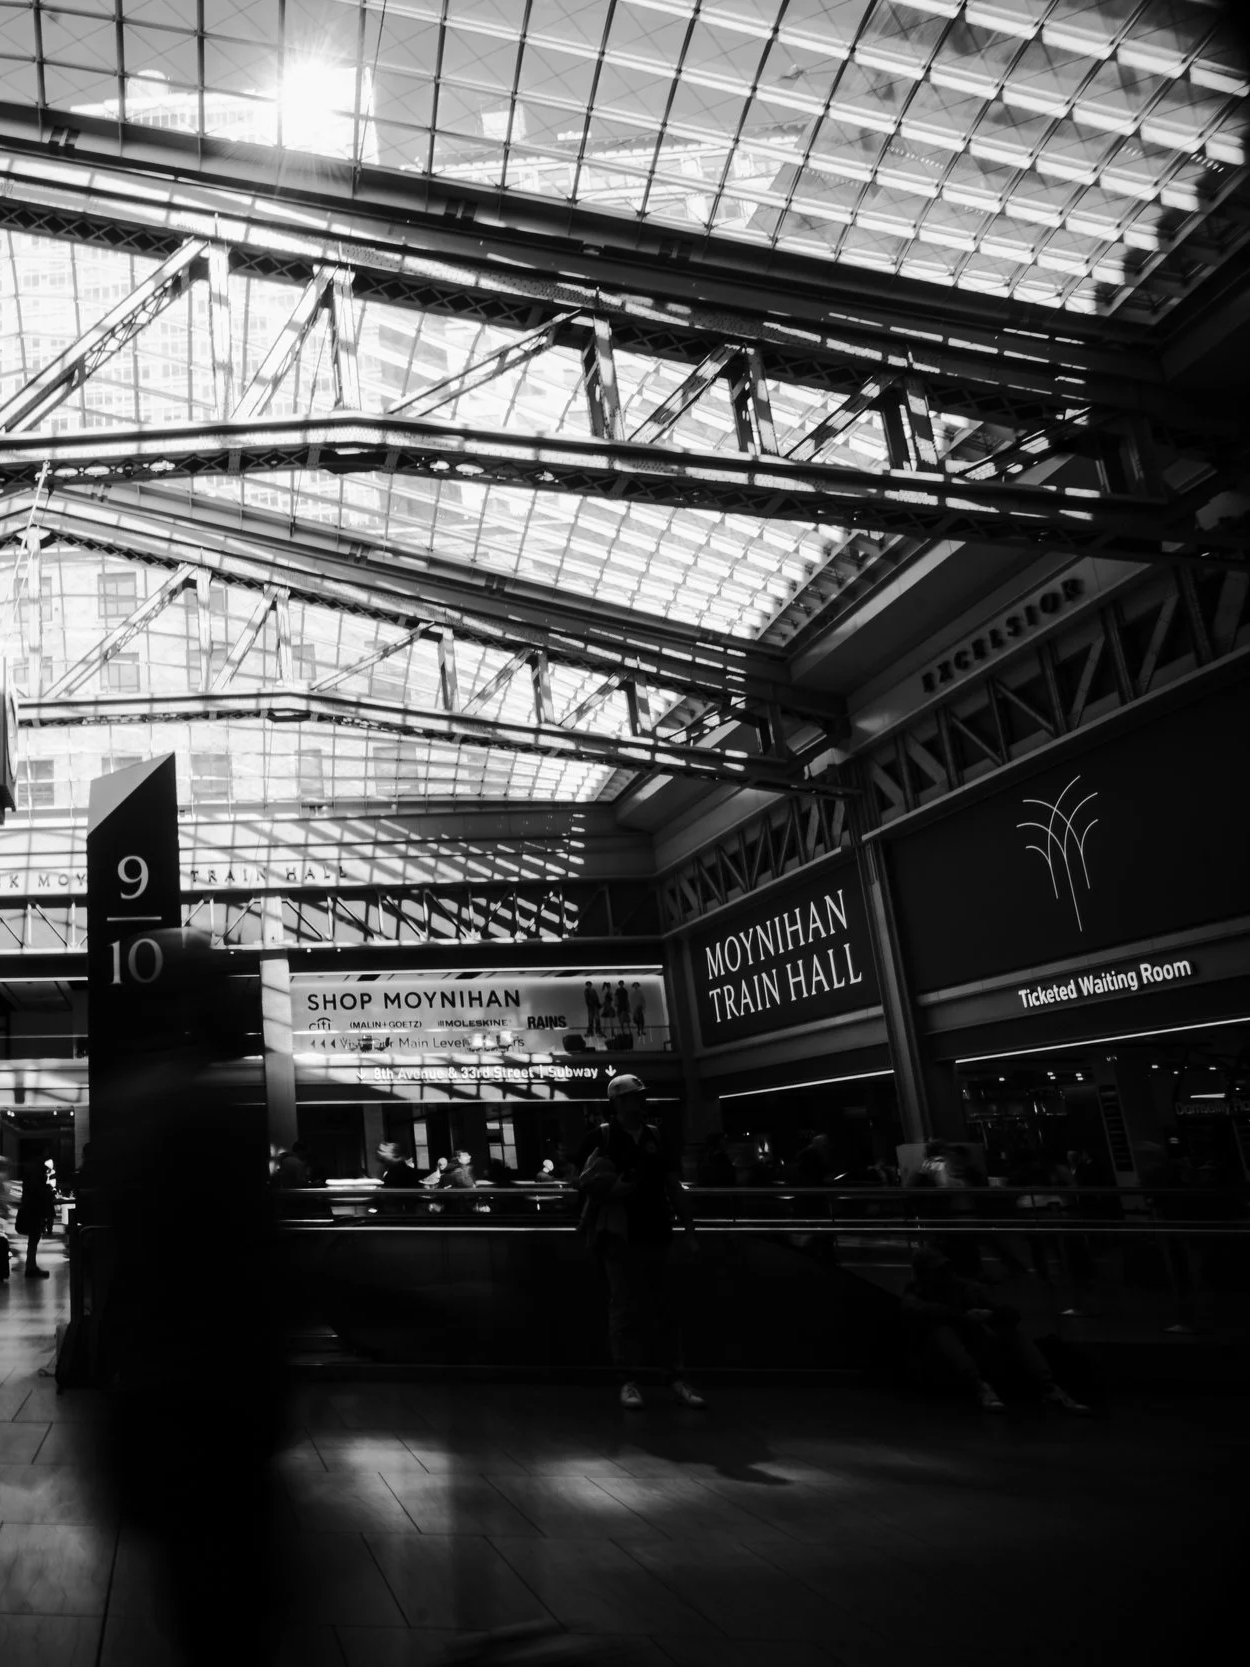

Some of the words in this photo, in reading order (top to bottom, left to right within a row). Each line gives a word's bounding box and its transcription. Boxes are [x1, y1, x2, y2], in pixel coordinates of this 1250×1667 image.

[117, 855, 149, 899] 9
[190, 867, 267, 883] TRAIN
[286, 865, 348, 881] HALL
[705, 889, 847, 980] MOYNIHAN
[109, 938, 163, 984] 10
[709, 968, 781, 1023] TRAIN
[785, 943, 862, 1001] HALL
[1018, 979, 1078, 1008] Ticketed
[1078, 970, 1139, 991] Waiting
[1139, 960, 1192, 985] Room
[307, 993, 372, 1011] SHOP
[383, 989, 521, 1010] MOYNIHAN
[308, 1017, 331, 1030] citi
[444, 1018, 509, 1028] MOLESKINE
[527, 1015, 567, 1030] RAINS
[398, 1037, 429, 1048] Main
[433, 1036, 466, 1048] Level
[373, 1067, 394, 1080] 8th
[398, 1067, 444, 1080] Avenue
[448, 1066, 458, 1079] &
[460, 1066, 491, 1079] 33rd
[493, 1065, 534, 1079] Street
[549, 1065, 599, 1079] Subway
